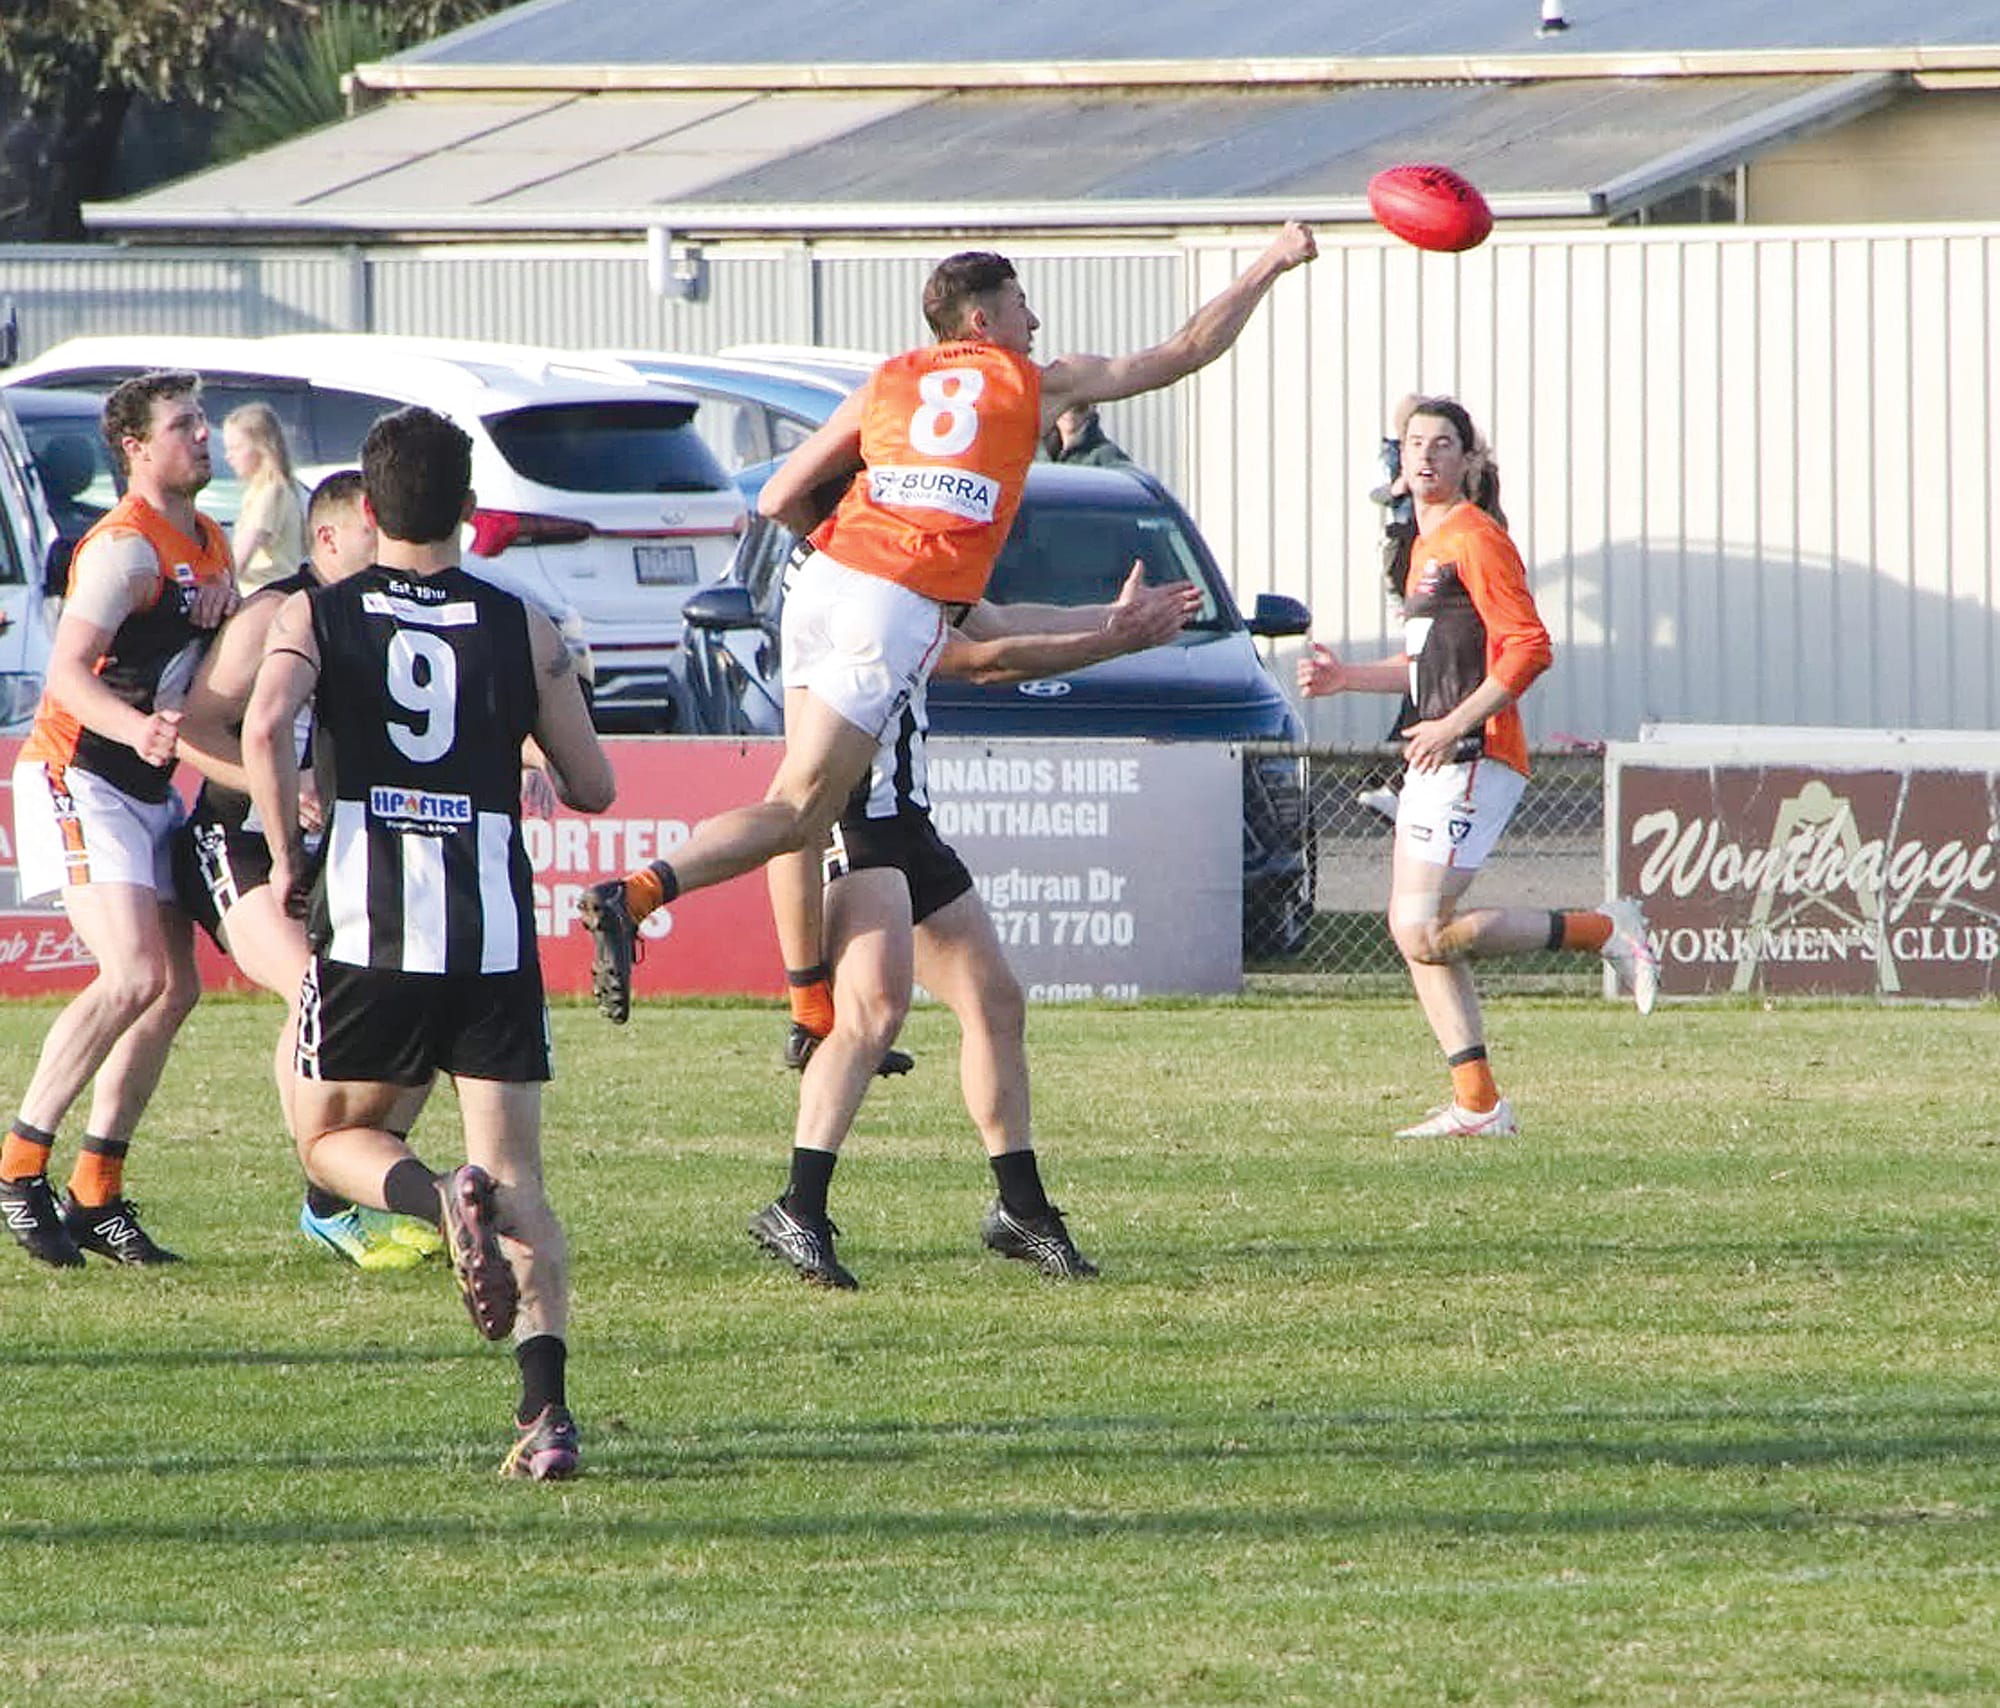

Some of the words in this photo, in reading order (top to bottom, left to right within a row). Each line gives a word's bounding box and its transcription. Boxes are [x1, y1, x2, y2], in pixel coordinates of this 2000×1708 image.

[909, 367, 985, 457] 8
[902, 473, 989, 506] BURRA
[386, 628, 457, 762] 9
[928, 758, 1053, 793] NNARDS
[1061, 759, 1140, 793] HIRE
[420, 795, 468, 818] FIRE
[1632, 809, 1998, 923] Wonthaggi
[973, 867, 1081, 908] ughran
[1088, 866, 1126, 902] Dr
[988, 911, 1041, 945] 671
[1050, 911, 1134, 946] 7700
[1893, 927, 2000, 962] CLUB
